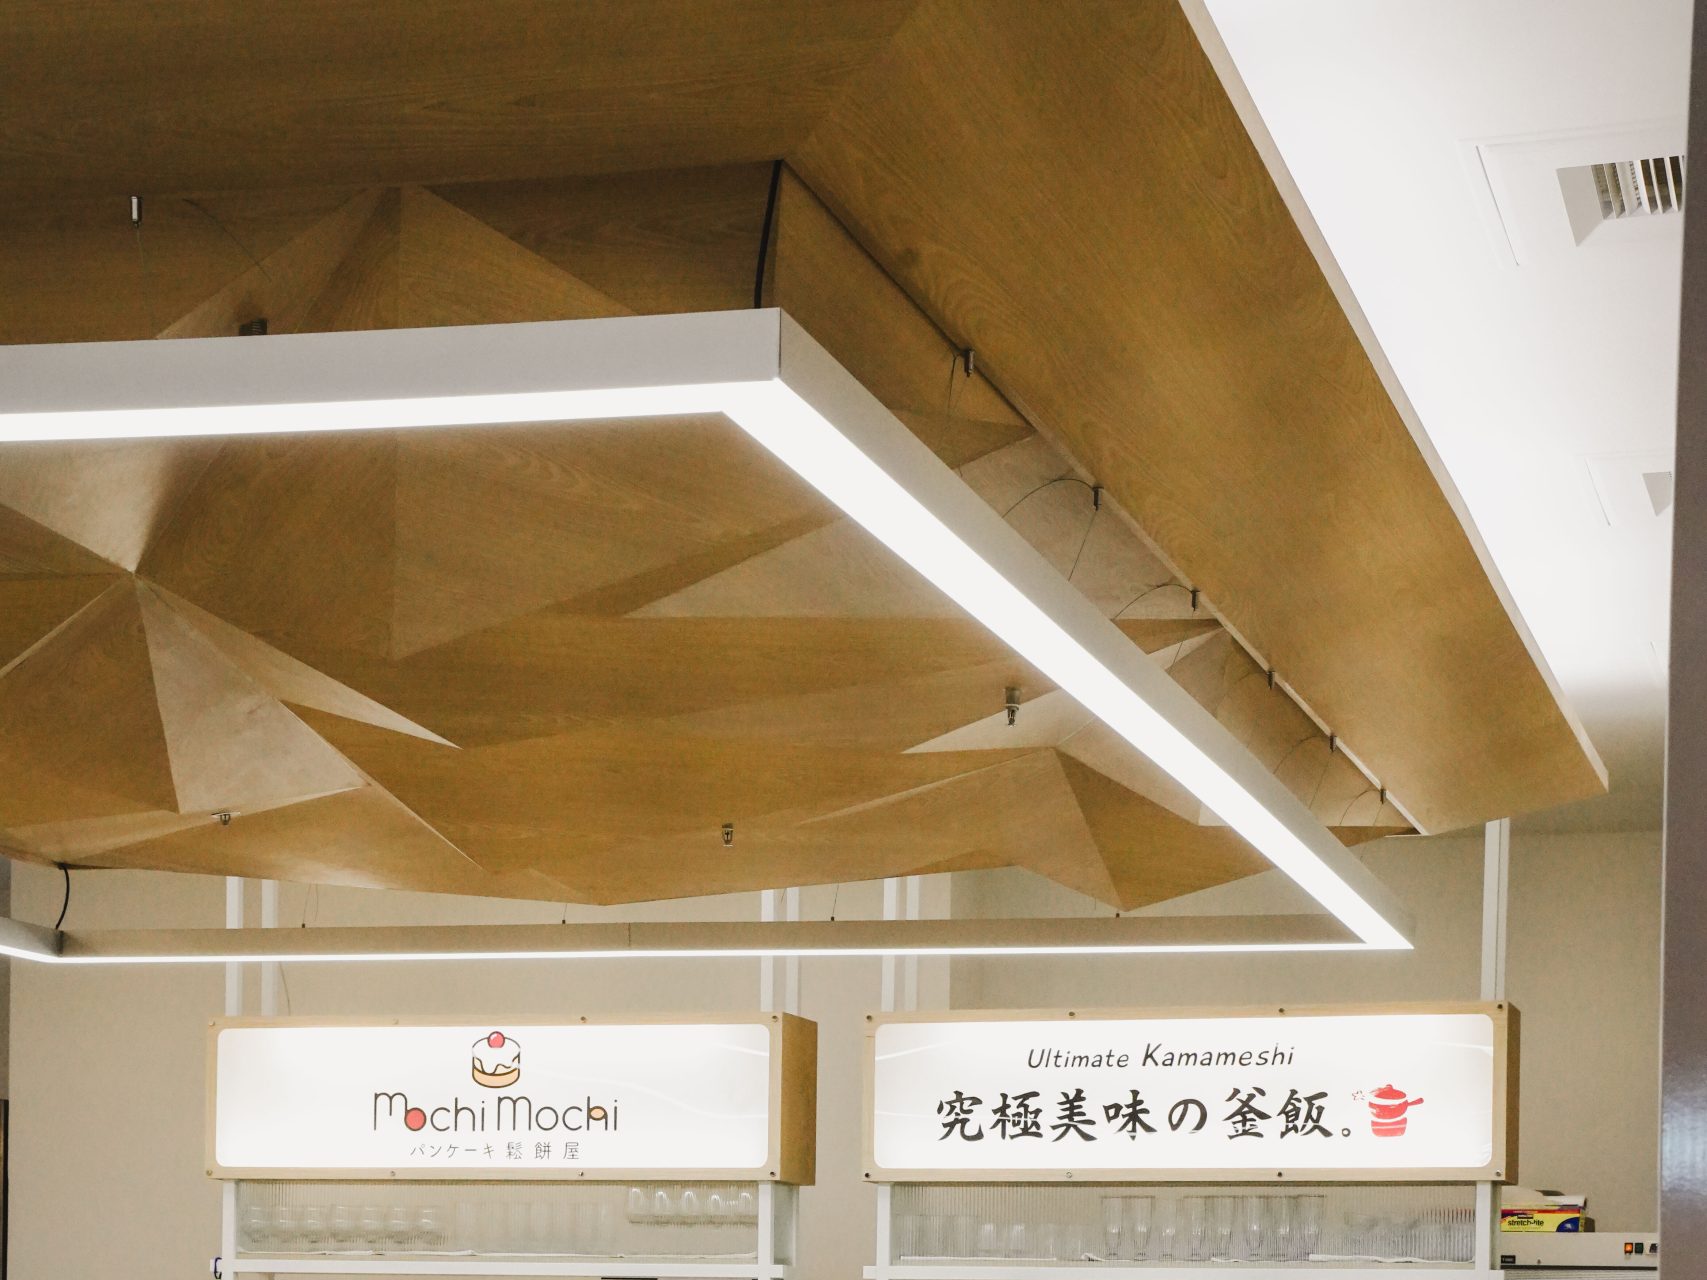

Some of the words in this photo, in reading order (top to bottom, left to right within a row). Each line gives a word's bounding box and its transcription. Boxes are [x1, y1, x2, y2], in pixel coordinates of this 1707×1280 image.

[1027, 1048, 1130, 1069] Ultimate
[1141, 1042, 1296, 1068] Kamameshi
[937, 1087, 1351, 1142] 究極美味の釜飯。
